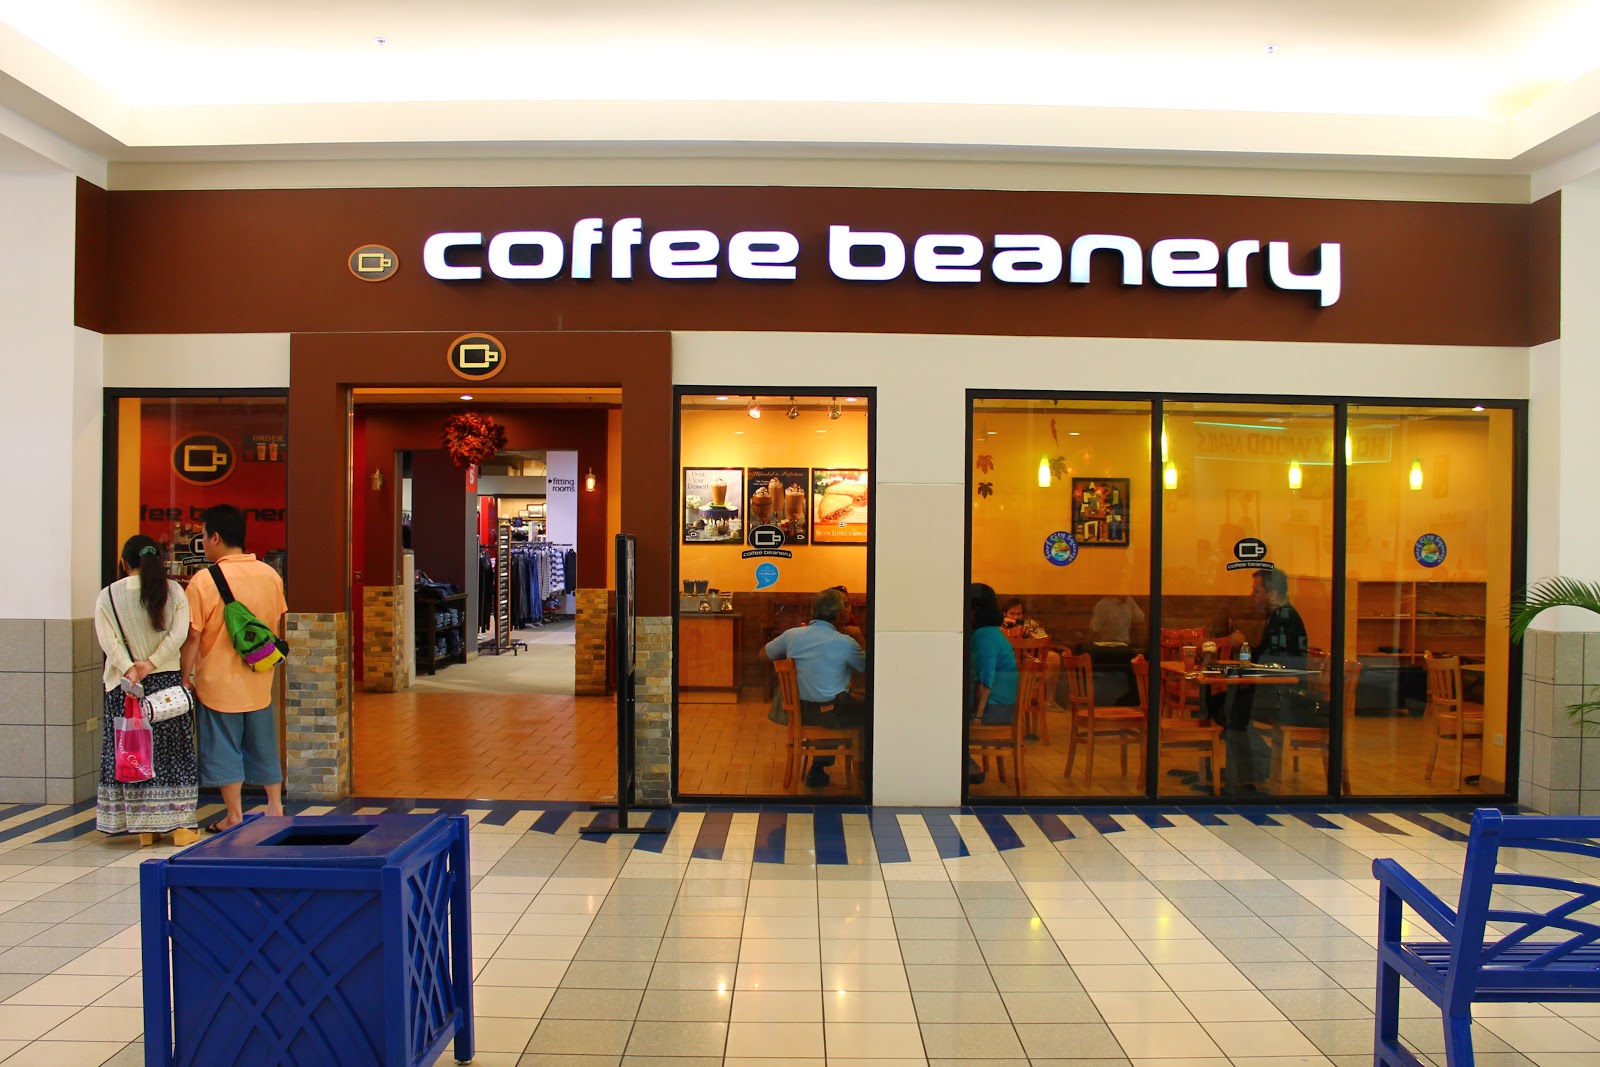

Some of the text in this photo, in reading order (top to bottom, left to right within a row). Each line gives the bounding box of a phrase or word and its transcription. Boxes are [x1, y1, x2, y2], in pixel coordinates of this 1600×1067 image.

[423, 217, 1341, 307] coffee beanery
[252, 434, 284, 442] ORDER
[553, 478, 575, 486] fitting
[140, 505, 183, 522] fee
[1050, 532, 1066, 541] City
[763, 550, 792, 558] beanery
[183, 557, 202, 565] coffee
